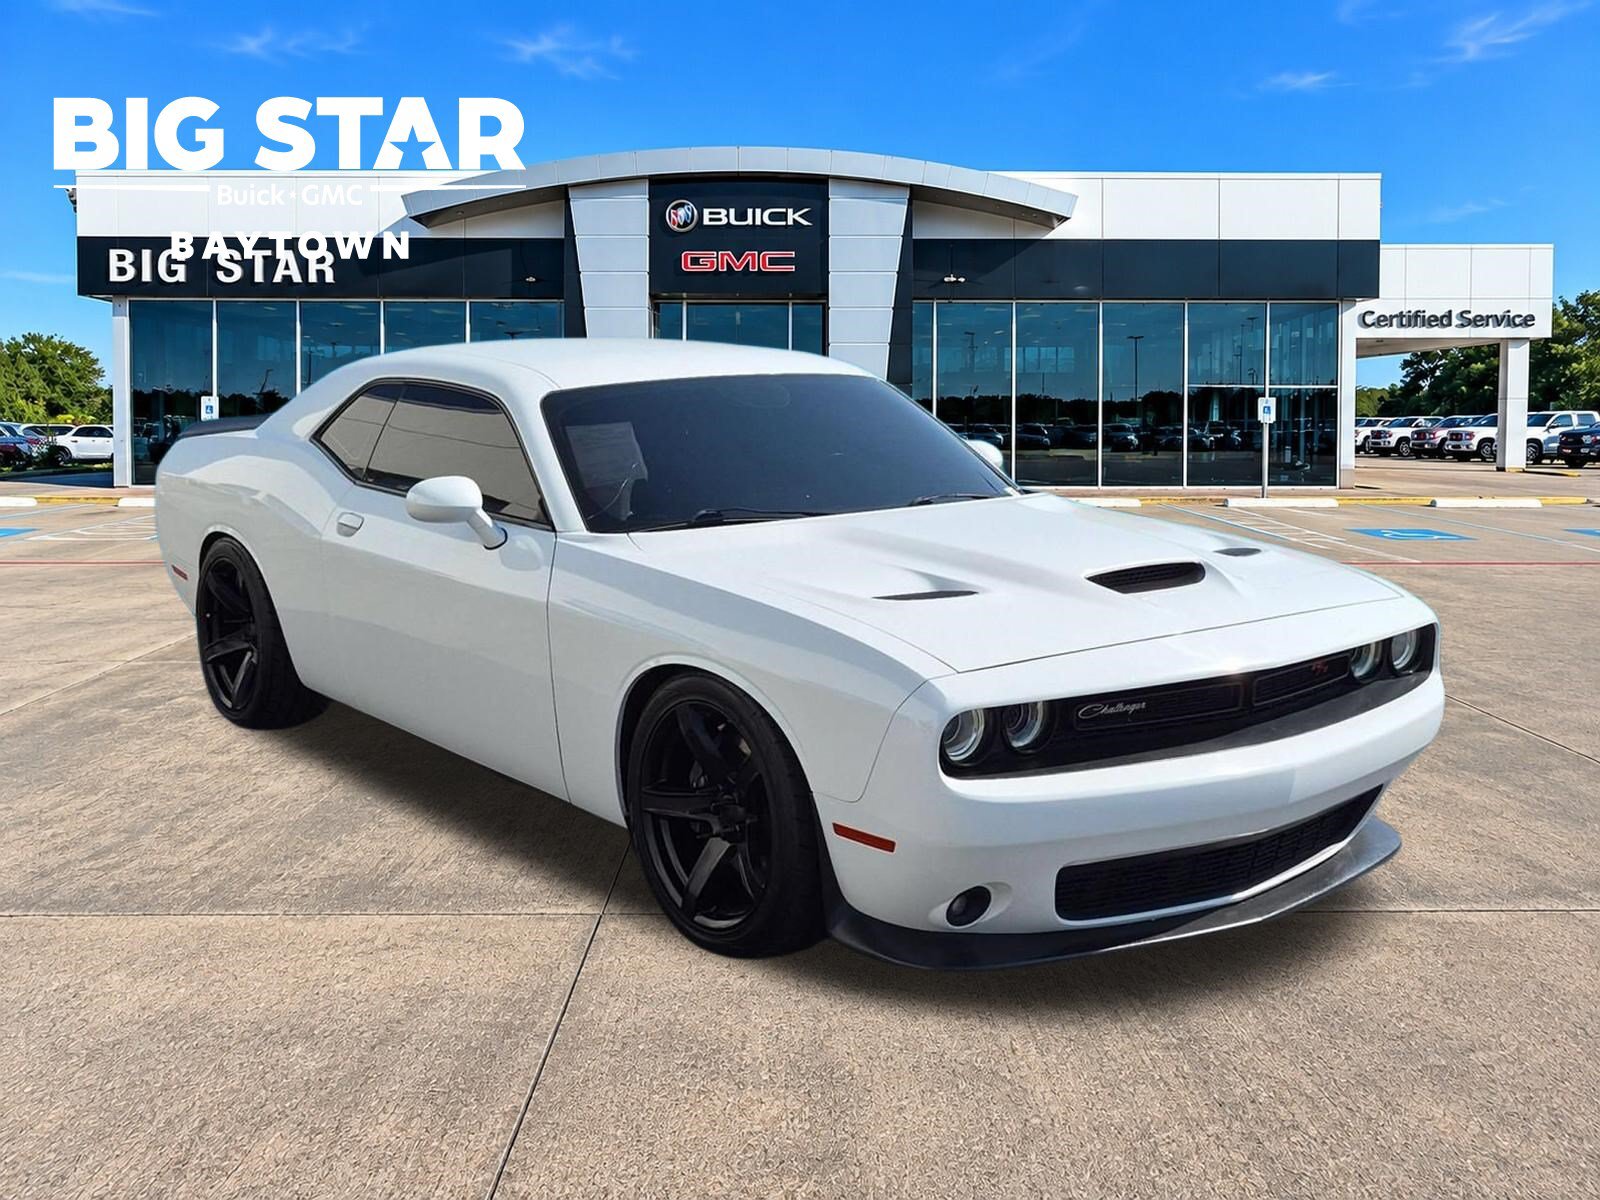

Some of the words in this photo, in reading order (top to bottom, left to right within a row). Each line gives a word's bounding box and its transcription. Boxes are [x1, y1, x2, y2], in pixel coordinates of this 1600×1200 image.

[703, 207, 813, 226] BUICK
[108, 248, 187, 283] BIG
[215, 248, 336, 284] STAR
[681, 250, 796, 272] GMC
[1357, 309, 1453, 329] Certified
[1455, 309, 1536, 329] Service
[1078, 702, 1147, 719] Challenger
